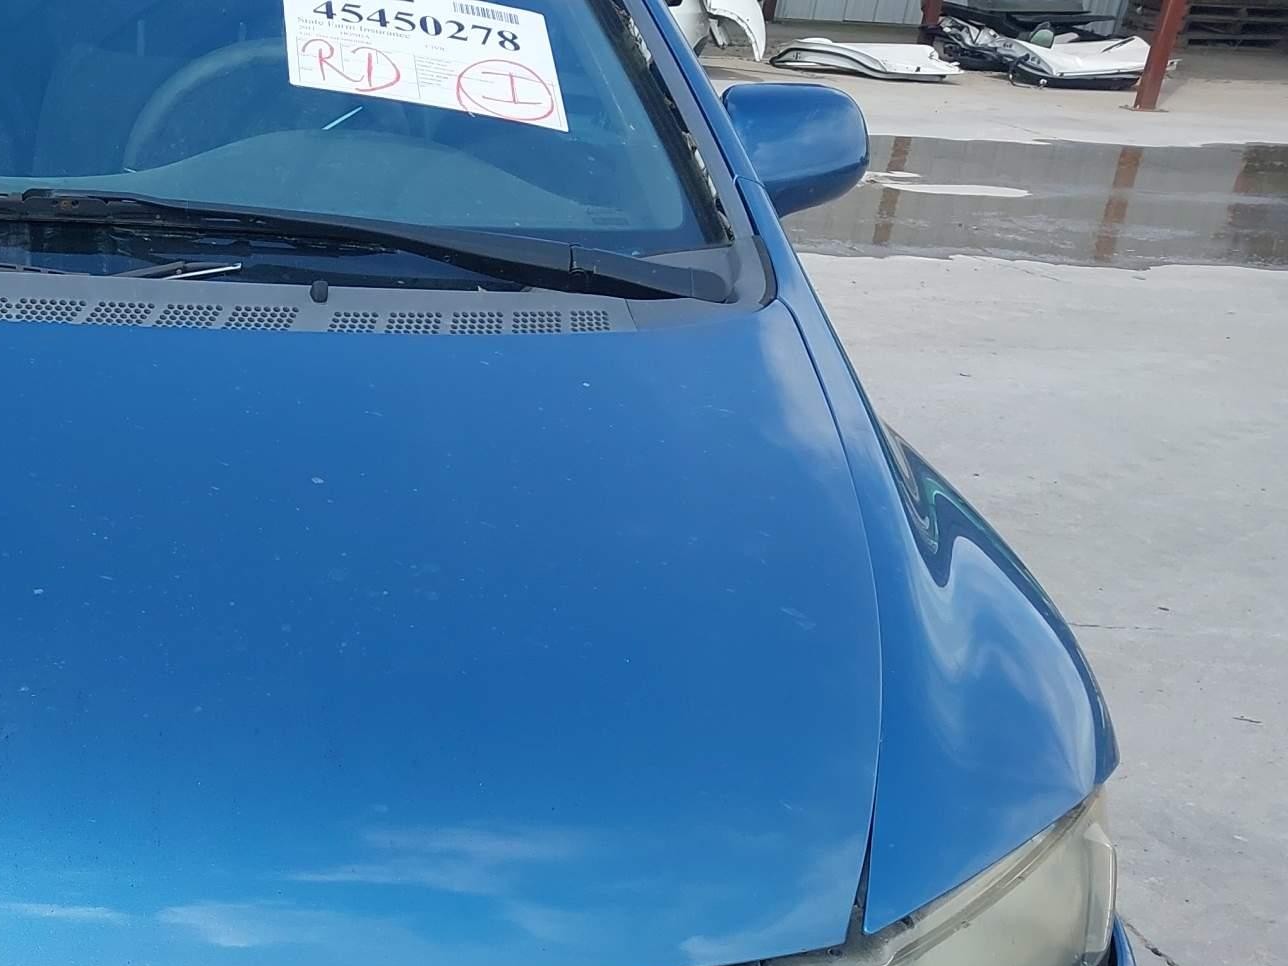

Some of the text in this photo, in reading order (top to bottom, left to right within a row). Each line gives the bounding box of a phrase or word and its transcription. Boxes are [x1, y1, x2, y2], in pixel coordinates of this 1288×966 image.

[297, 16, 324, 26] State
[359, 25, 410, 39] Insurance
[313, 0, 521, 52] 45450278
